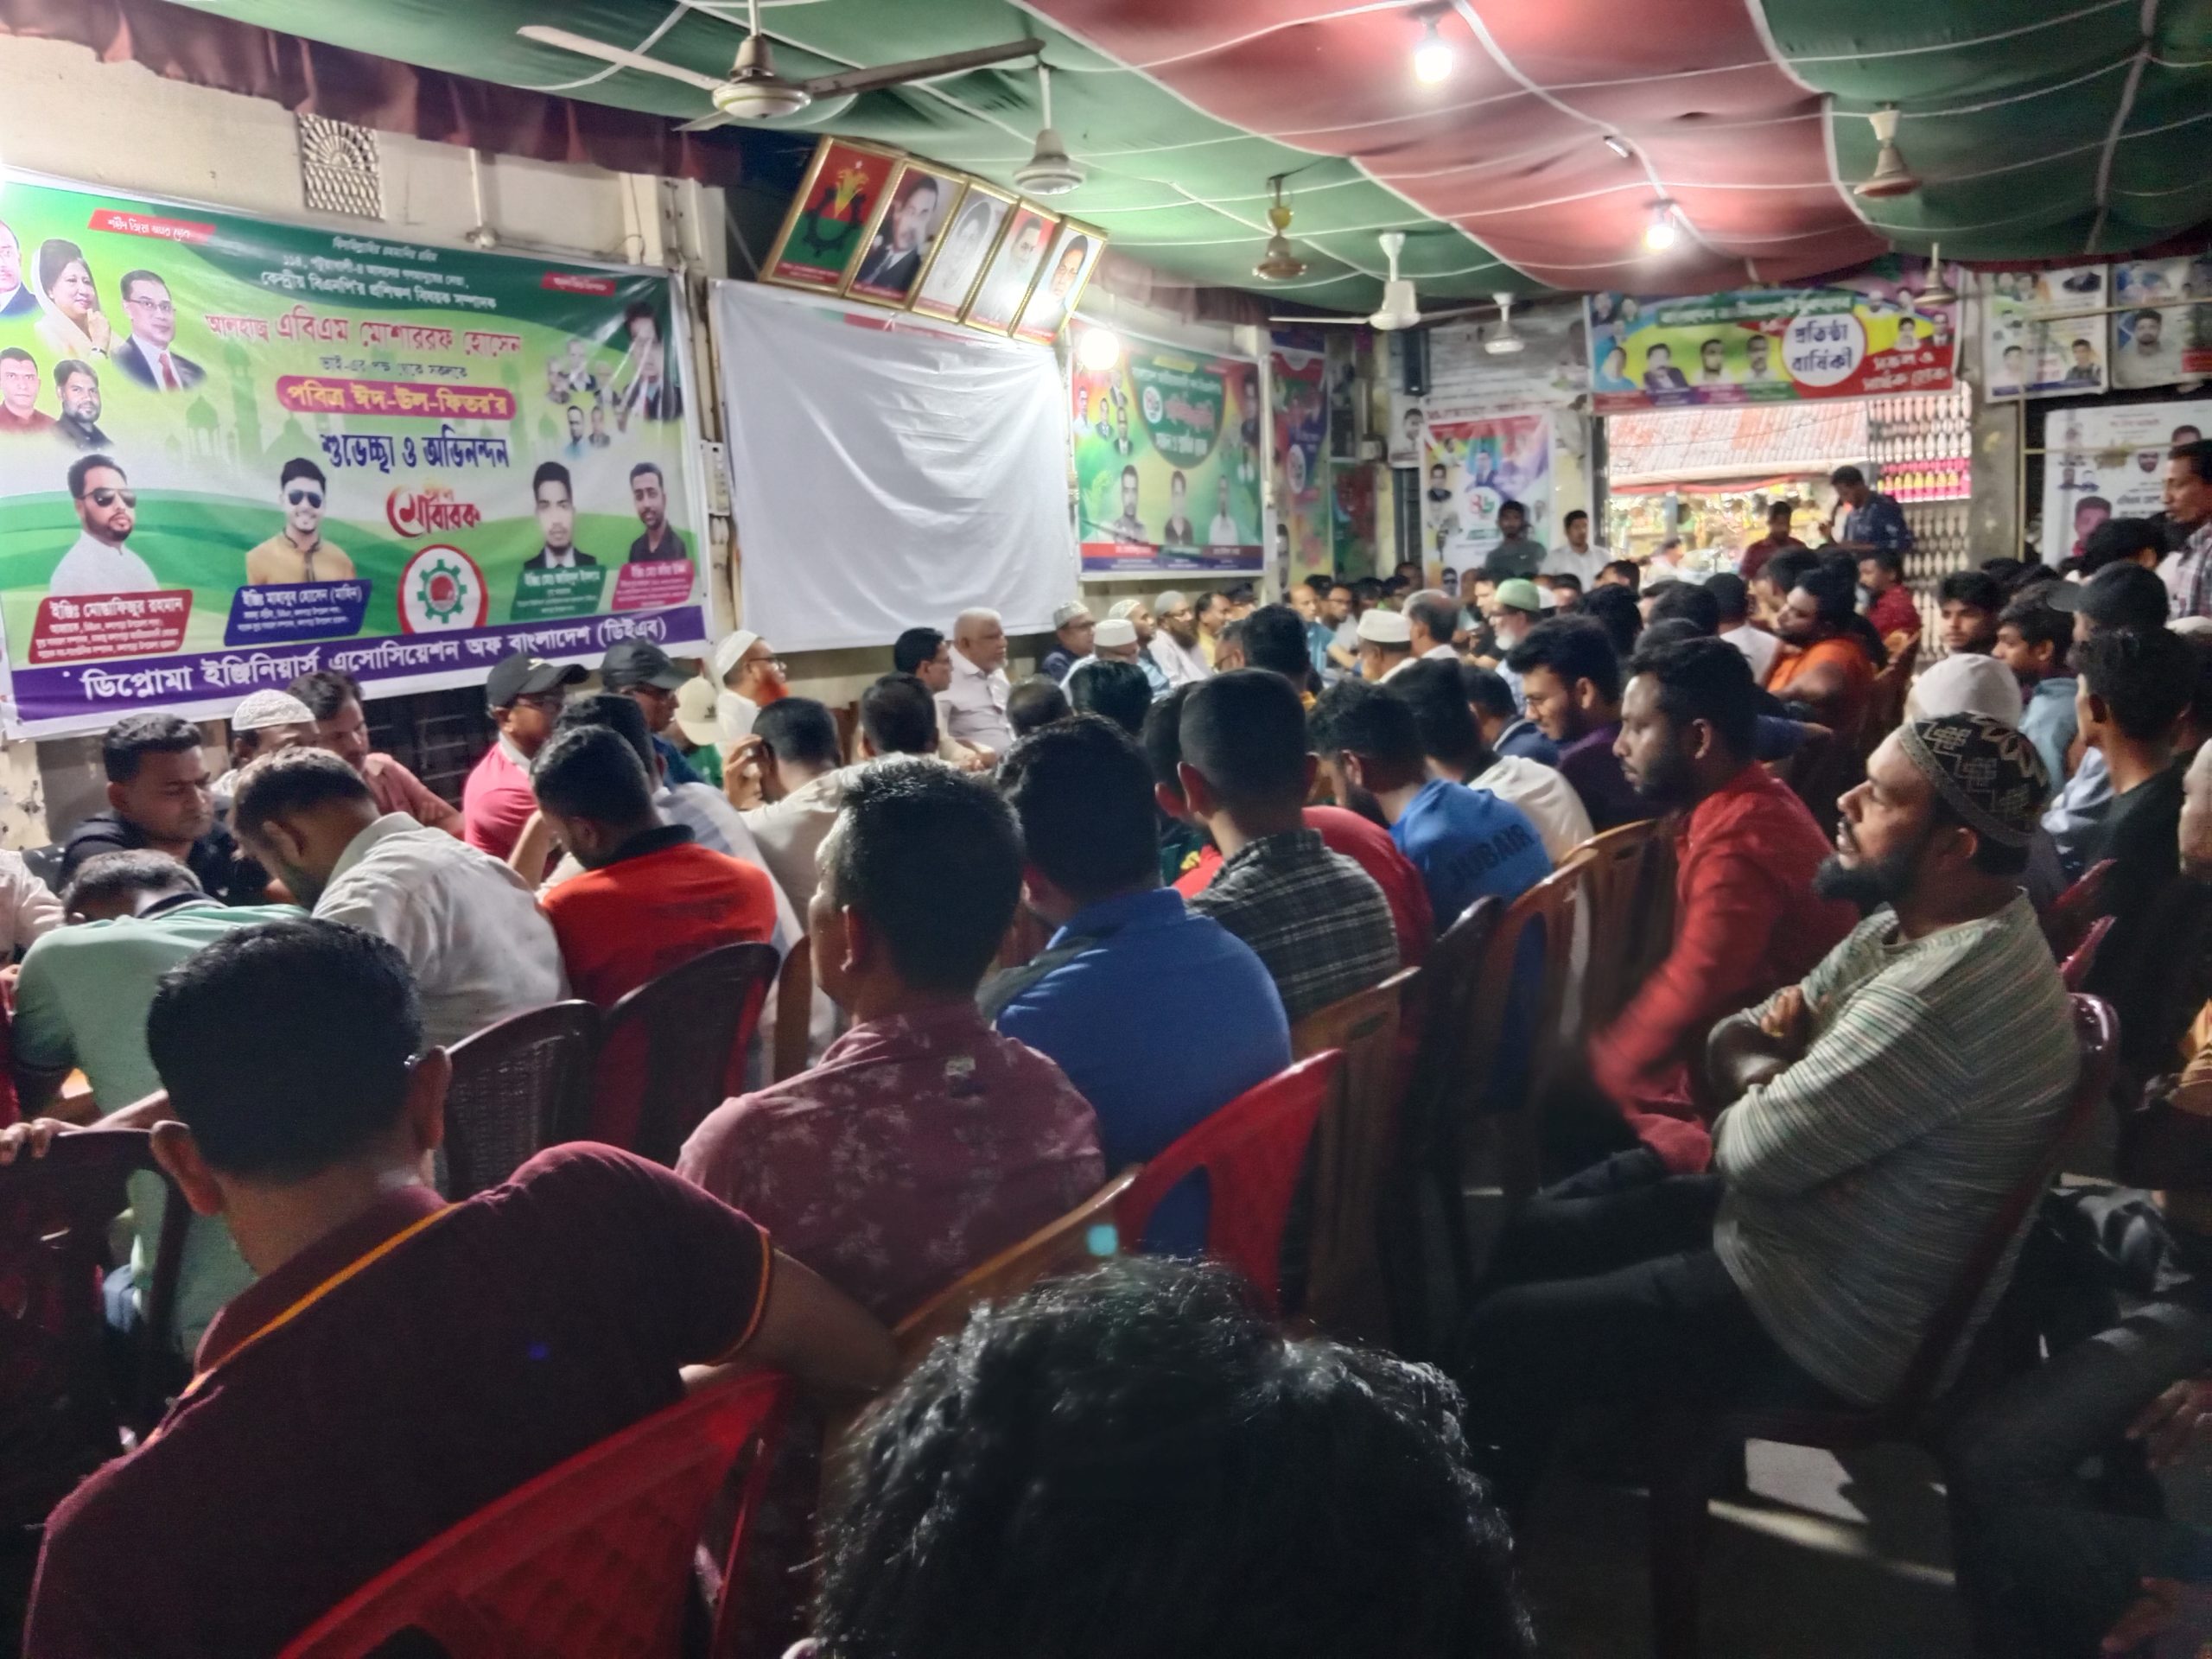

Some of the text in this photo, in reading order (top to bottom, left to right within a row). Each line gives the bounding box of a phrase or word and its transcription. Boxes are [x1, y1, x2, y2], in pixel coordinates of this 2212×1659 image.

[276, 304, 349, 344] এবিএম
[359, 321, 453, 351] মোশাররফ
[463, 331, 521, 357] হোসেন
[286, 378, 345, 408] পবিত্র
[320, 423, 510, 474] শুভেচ্ছা ও অভিনন্দন
[147, 597, 184, 613] রহমান
[79, 665, 193, 701] ডিপ্লোমা
[200, 646, 321, 689] ইঞ্জিনিয়ার্স
[328, 639, 459, 675] এসোসিয়েশন
[466, 636, 502, 658] অফ
[506, 624, 591, 653] বাংলাদেশ
[596, 616, 667, 648] (ডিইএব)
[1449, 823, 1535, 880] JUBAIR
